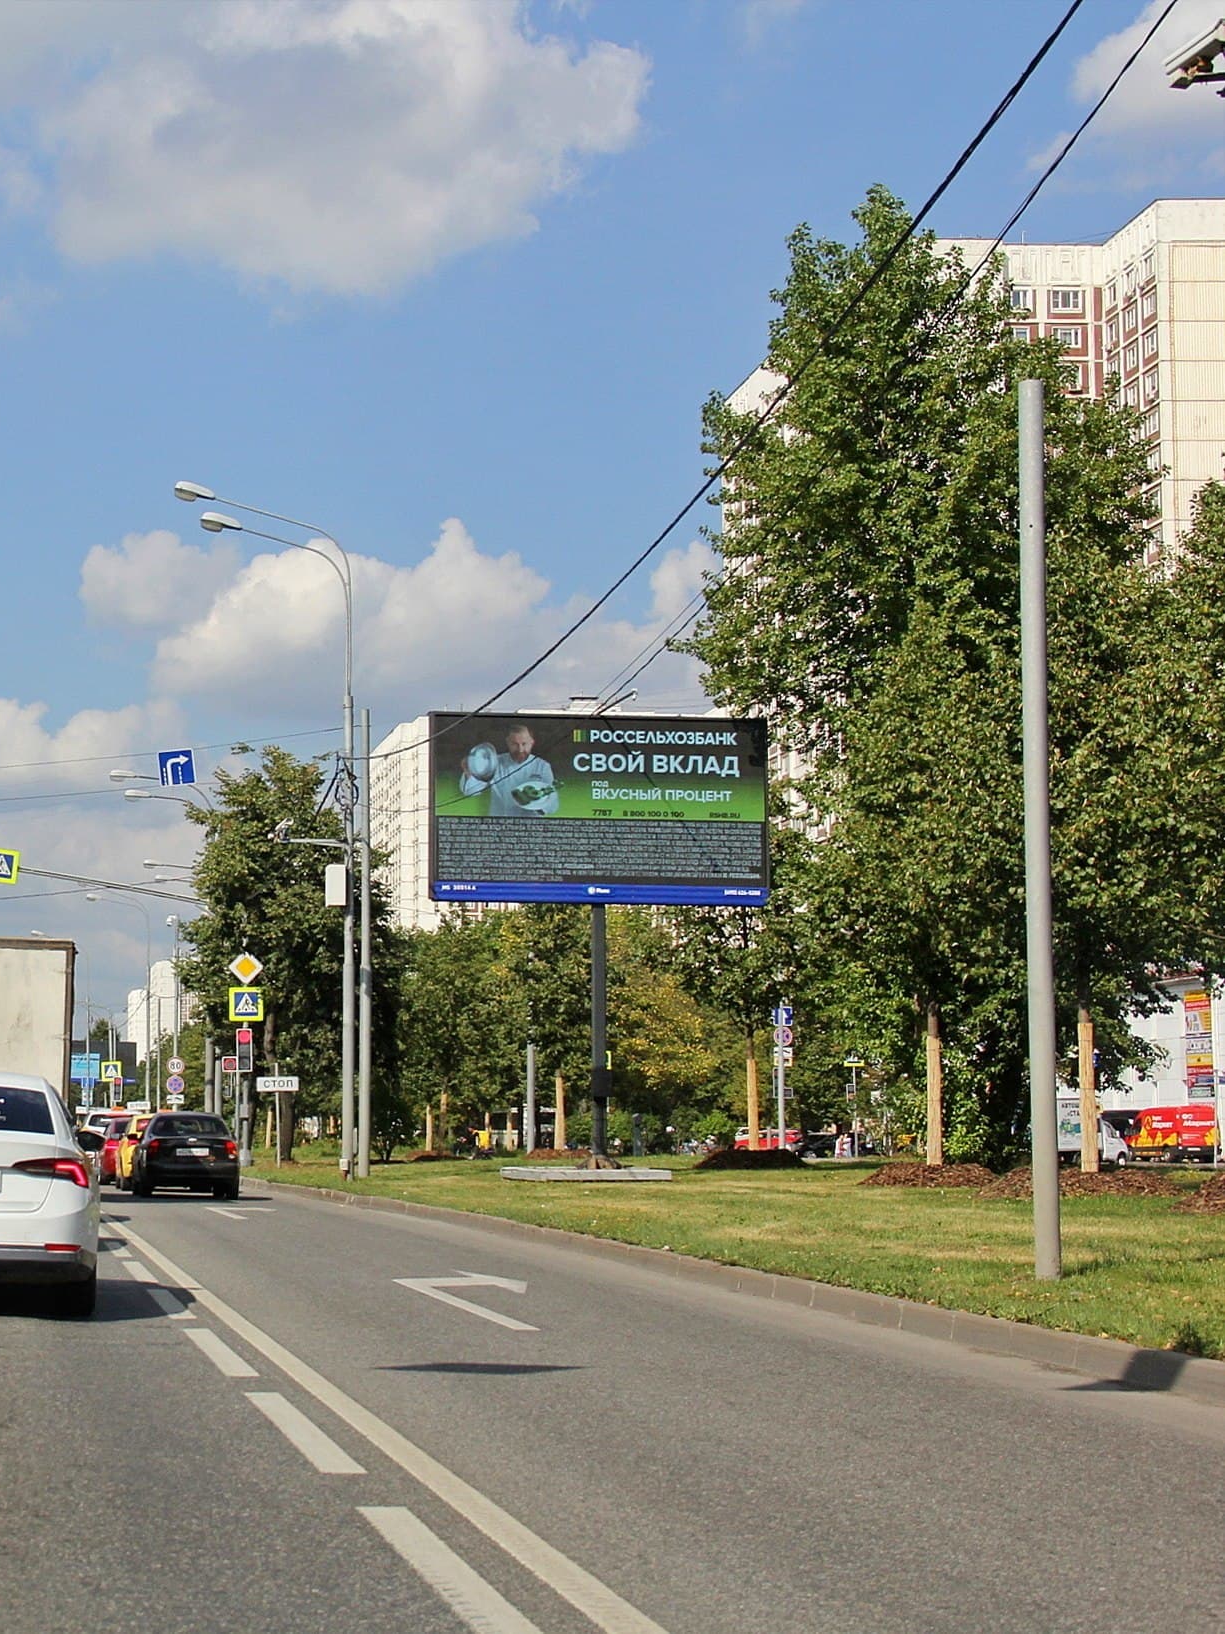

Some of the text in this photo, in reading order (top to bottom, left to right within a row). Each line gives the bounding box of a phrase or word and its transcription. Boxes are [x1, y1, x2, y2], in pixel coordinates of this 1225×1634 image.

[590, 729, 738, 746] РОССЕЛЬХОЗБАНК
[572, 750, 741, 778] СВОЙ ВКЛАД
[591, 780, 610, 789] под
[591, 787, 733, 803] ВКУСНЫЙ ПРОЦЕНТ
[169, 1061, 182, 1070] 80
[263, 1078, 294, 1089] СТОП
